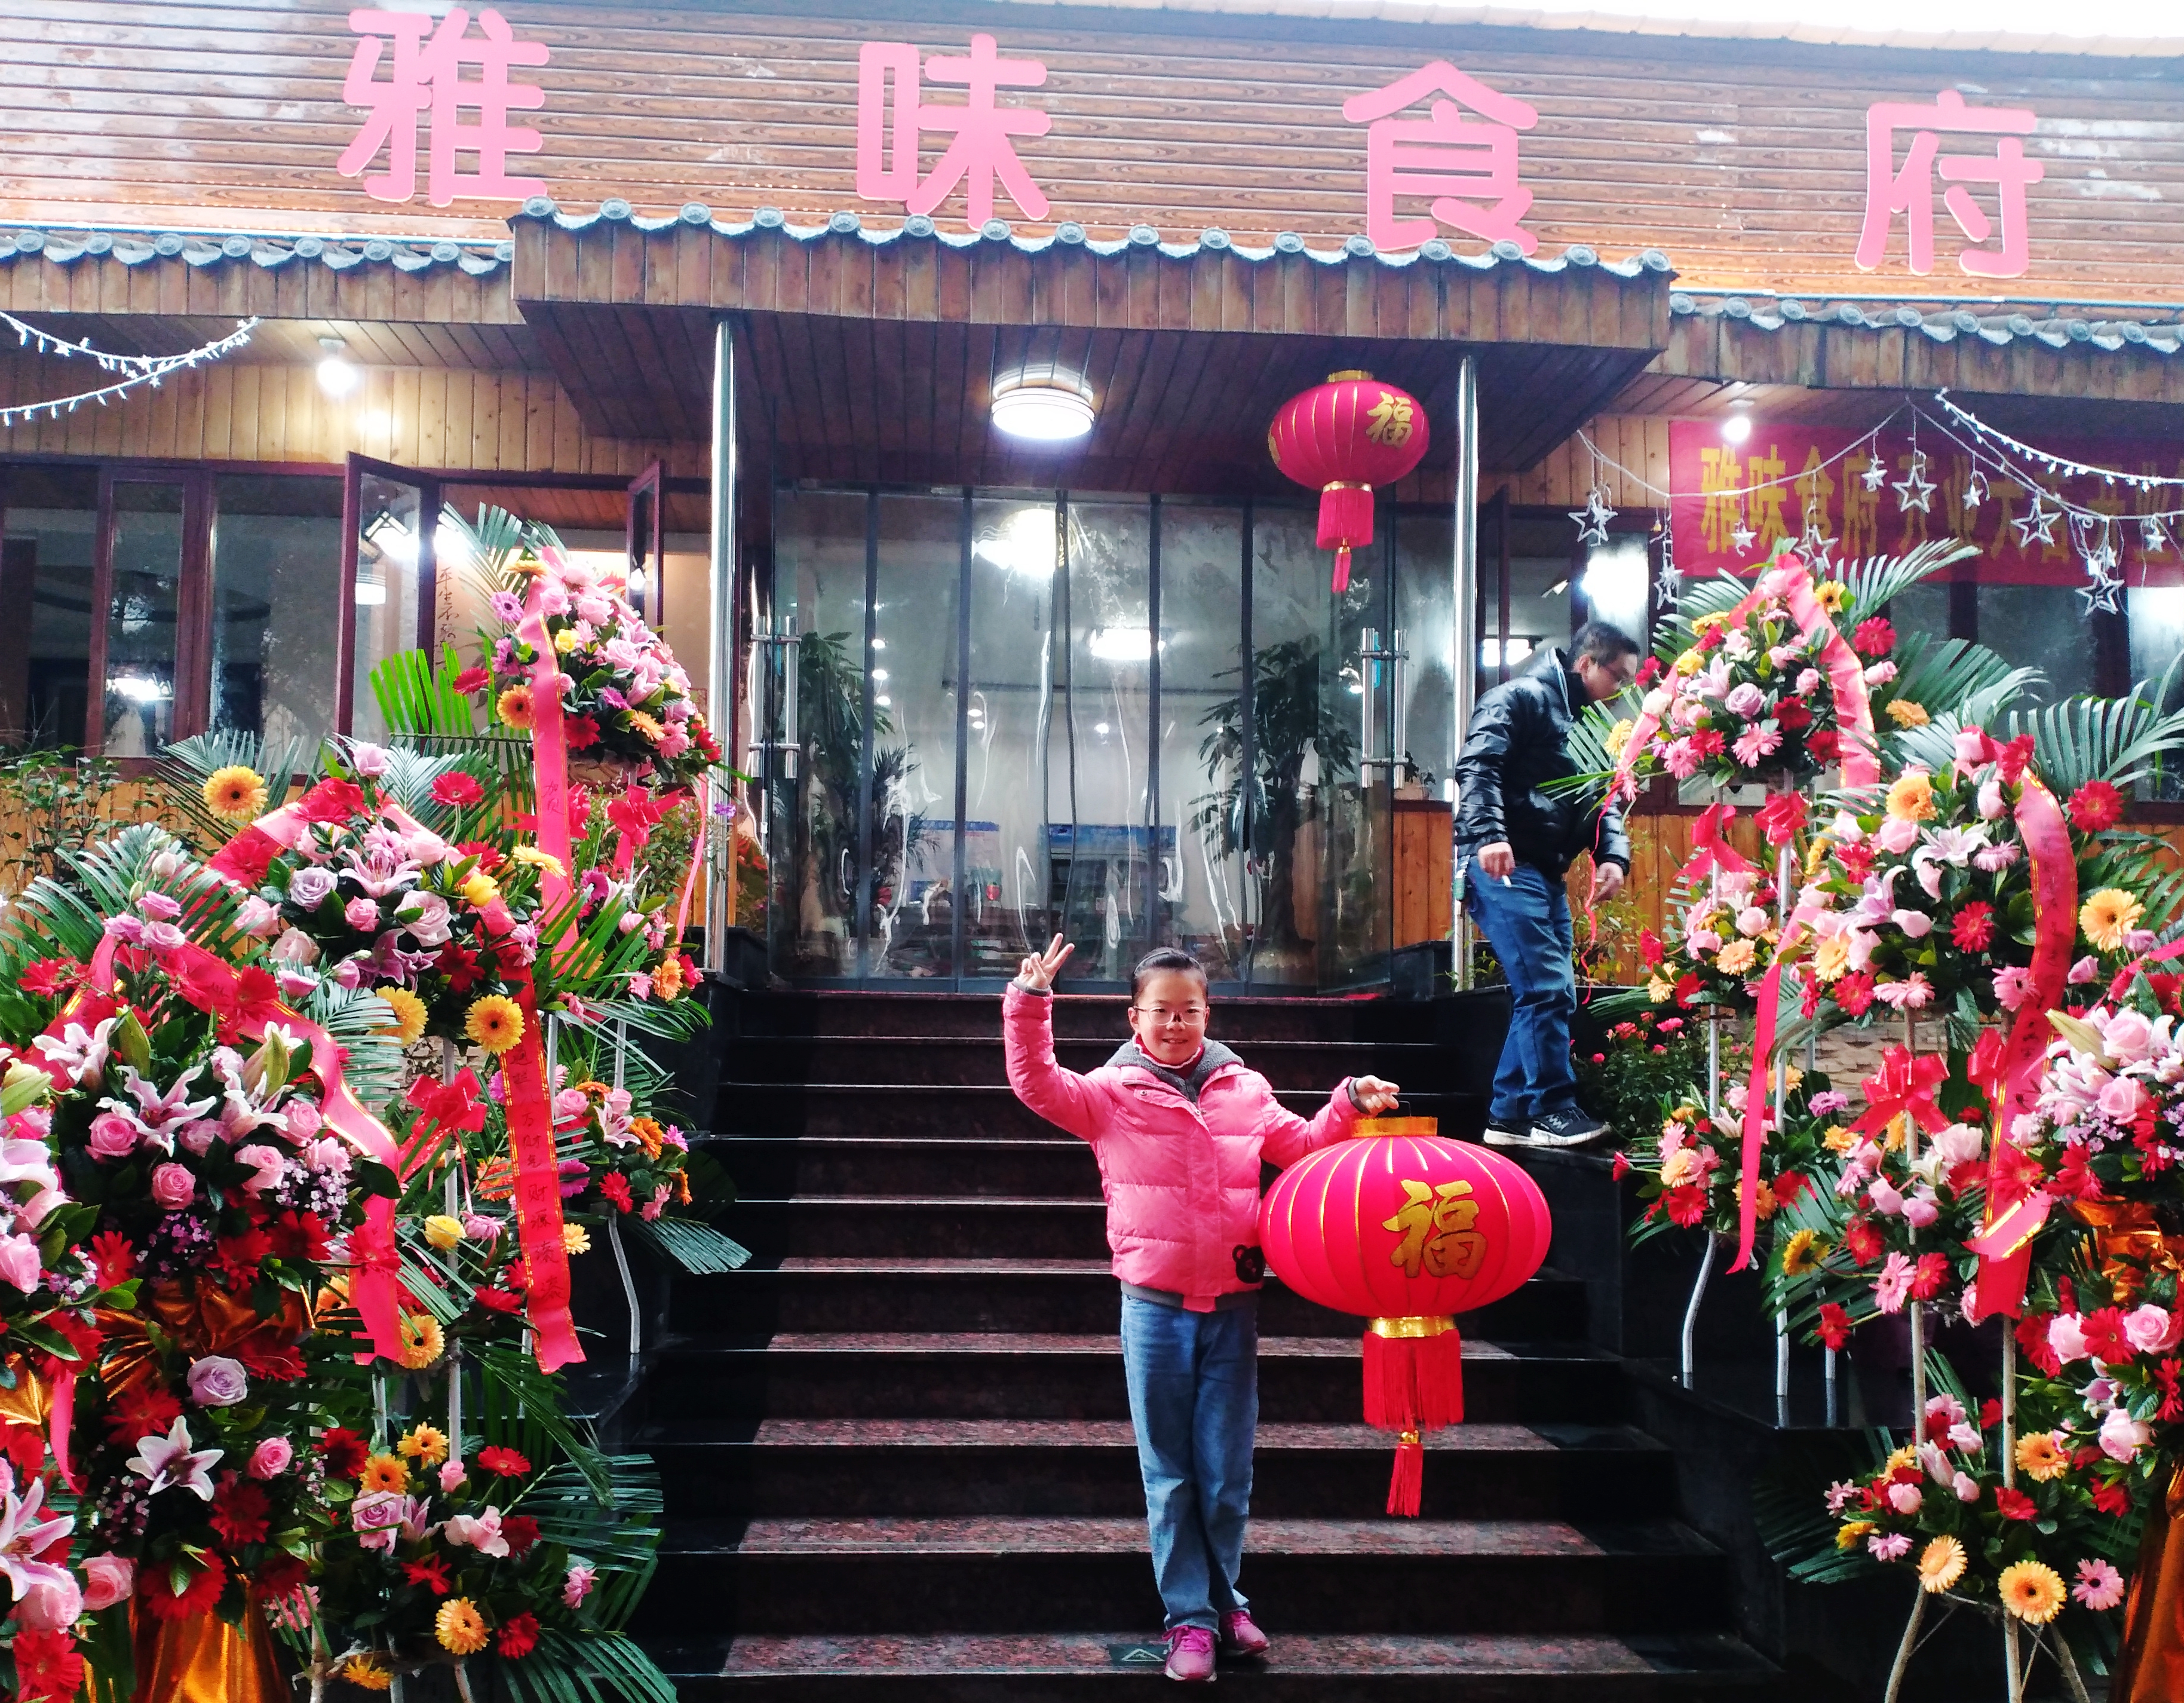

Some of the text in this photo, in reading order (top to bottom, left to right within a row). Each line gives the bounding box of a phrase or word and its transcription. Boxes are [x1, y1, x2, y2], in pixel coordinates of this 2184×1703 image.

[337, 7, 2045, 278] 雅味食府
[1366, 390, 1413, 448] 福
[1700, 443, 2184, 563] 雅味食府开业大吉开业
[1382, 1179, 1487, 1279] 福
